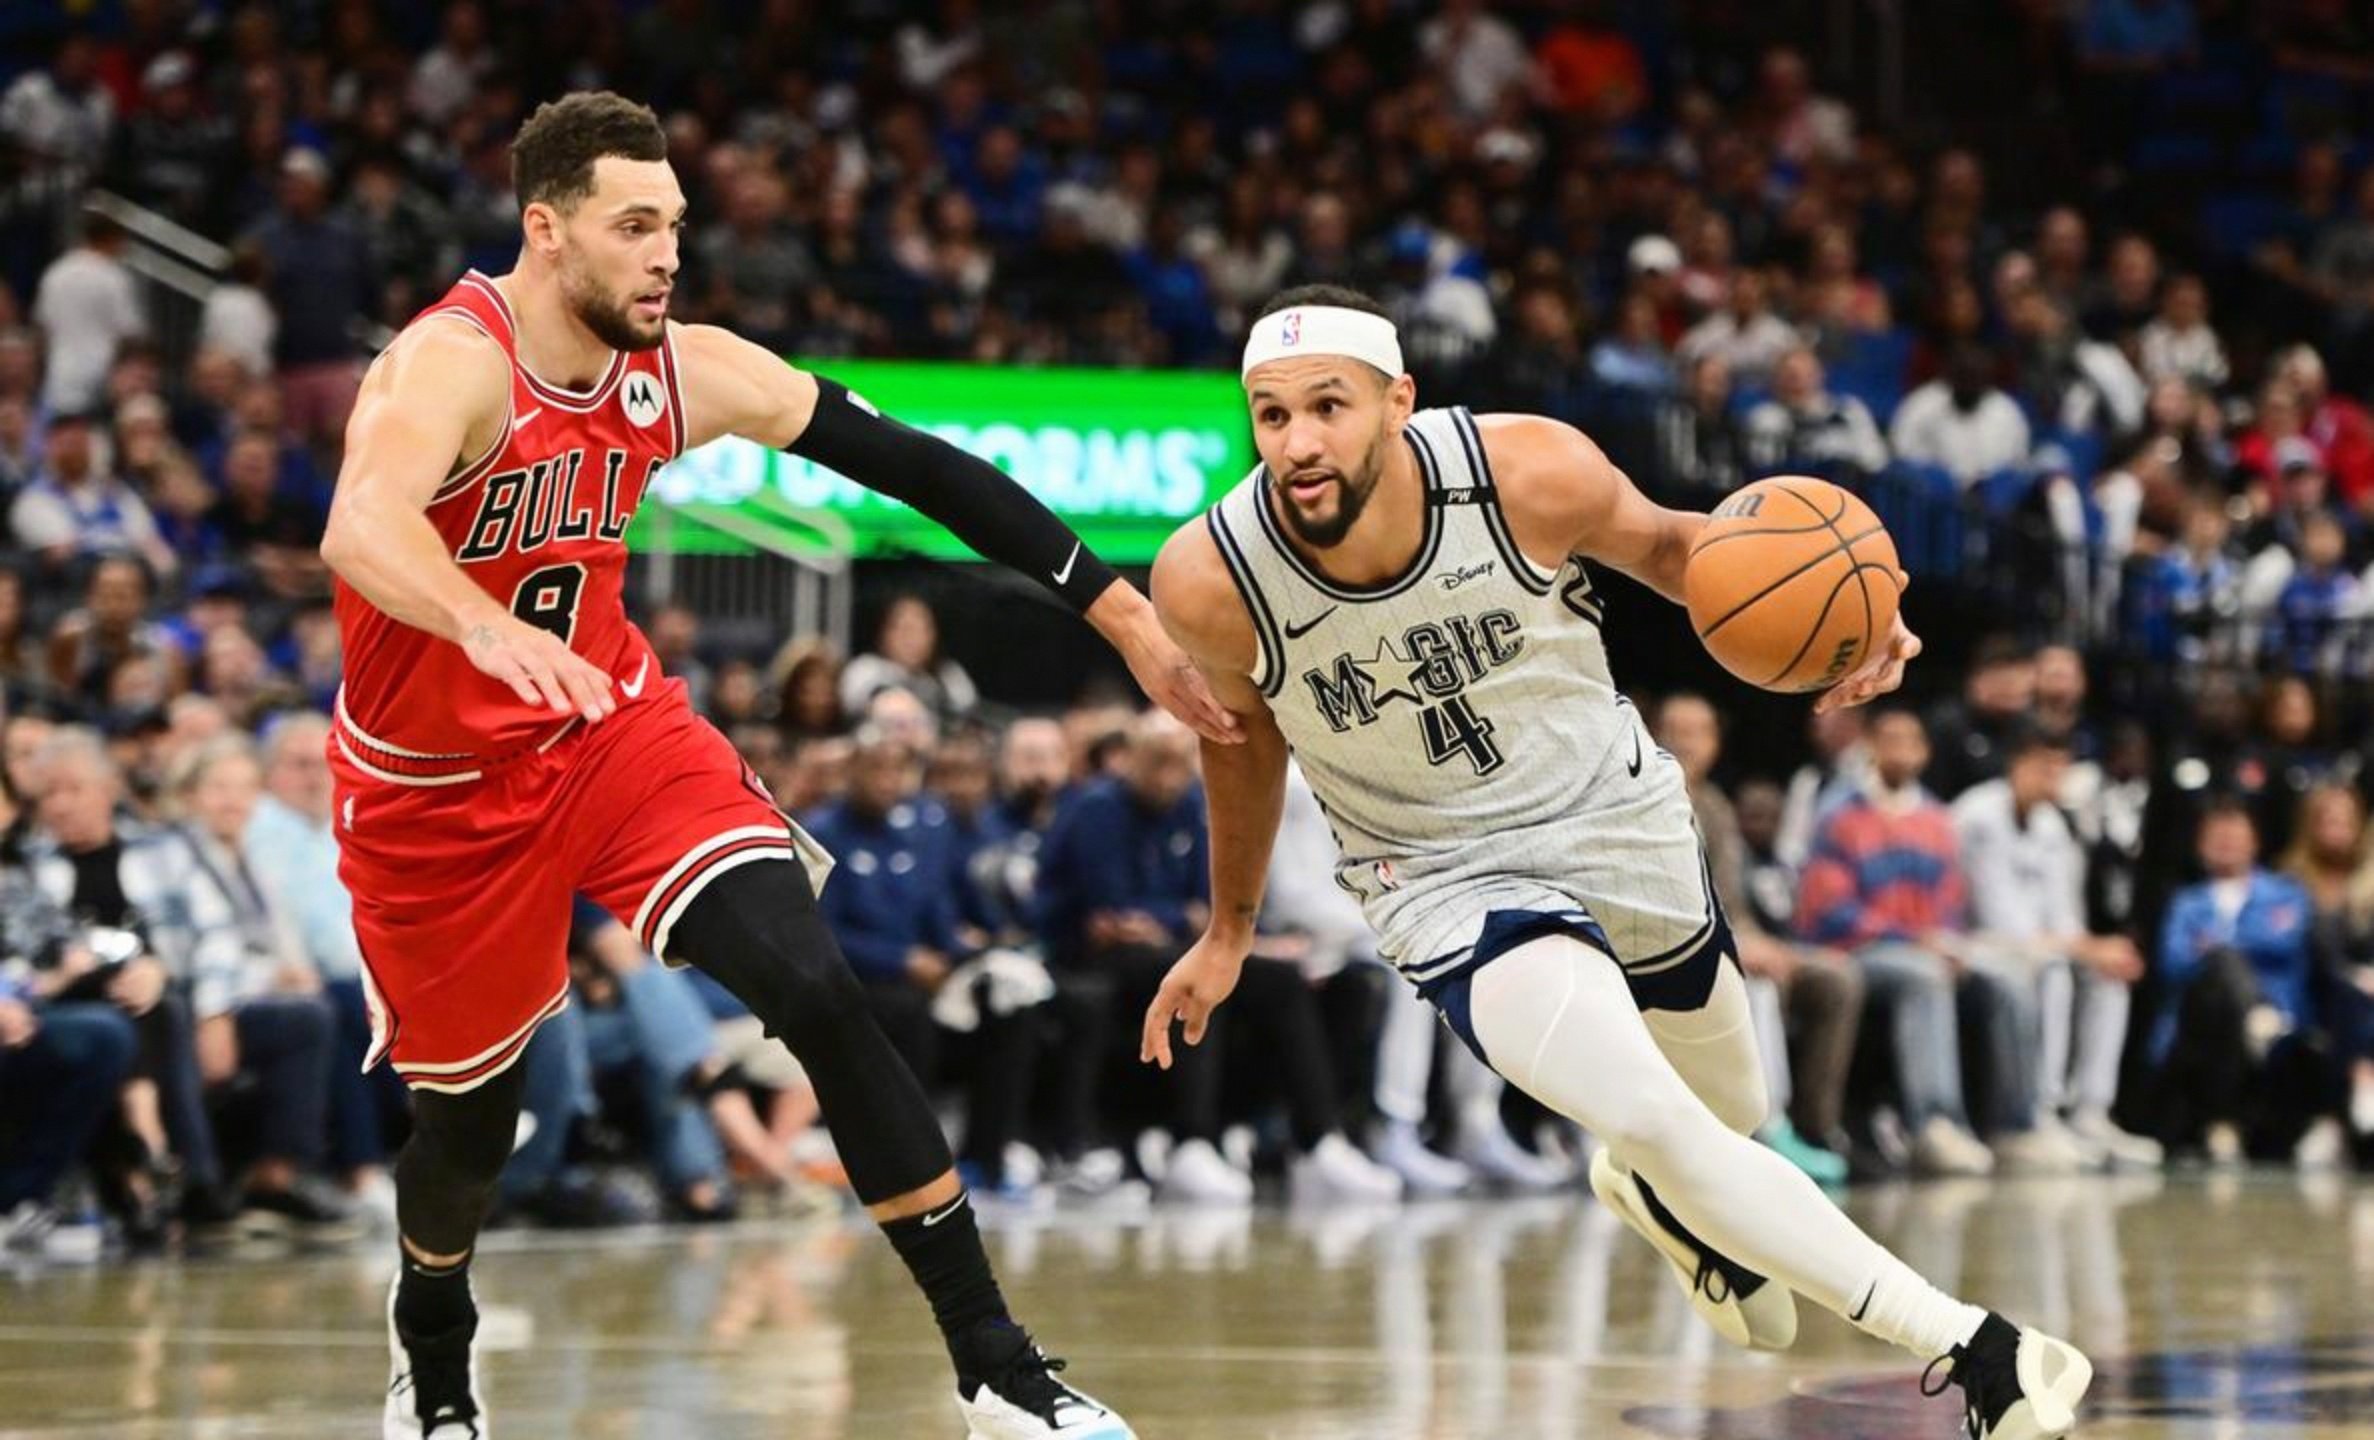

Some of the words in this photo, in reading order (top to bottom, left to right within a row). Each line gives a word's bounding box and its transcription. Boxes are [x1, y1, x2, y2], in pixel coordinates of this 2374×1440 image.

[455, 448, 667, 563] BULL
[775, 424, 1207, 517] UORMS
[1447, 489, 1472, 503] PW
[1434, 560, 1496, 590] Disney
[1416, 693, 1506, 777] 4
